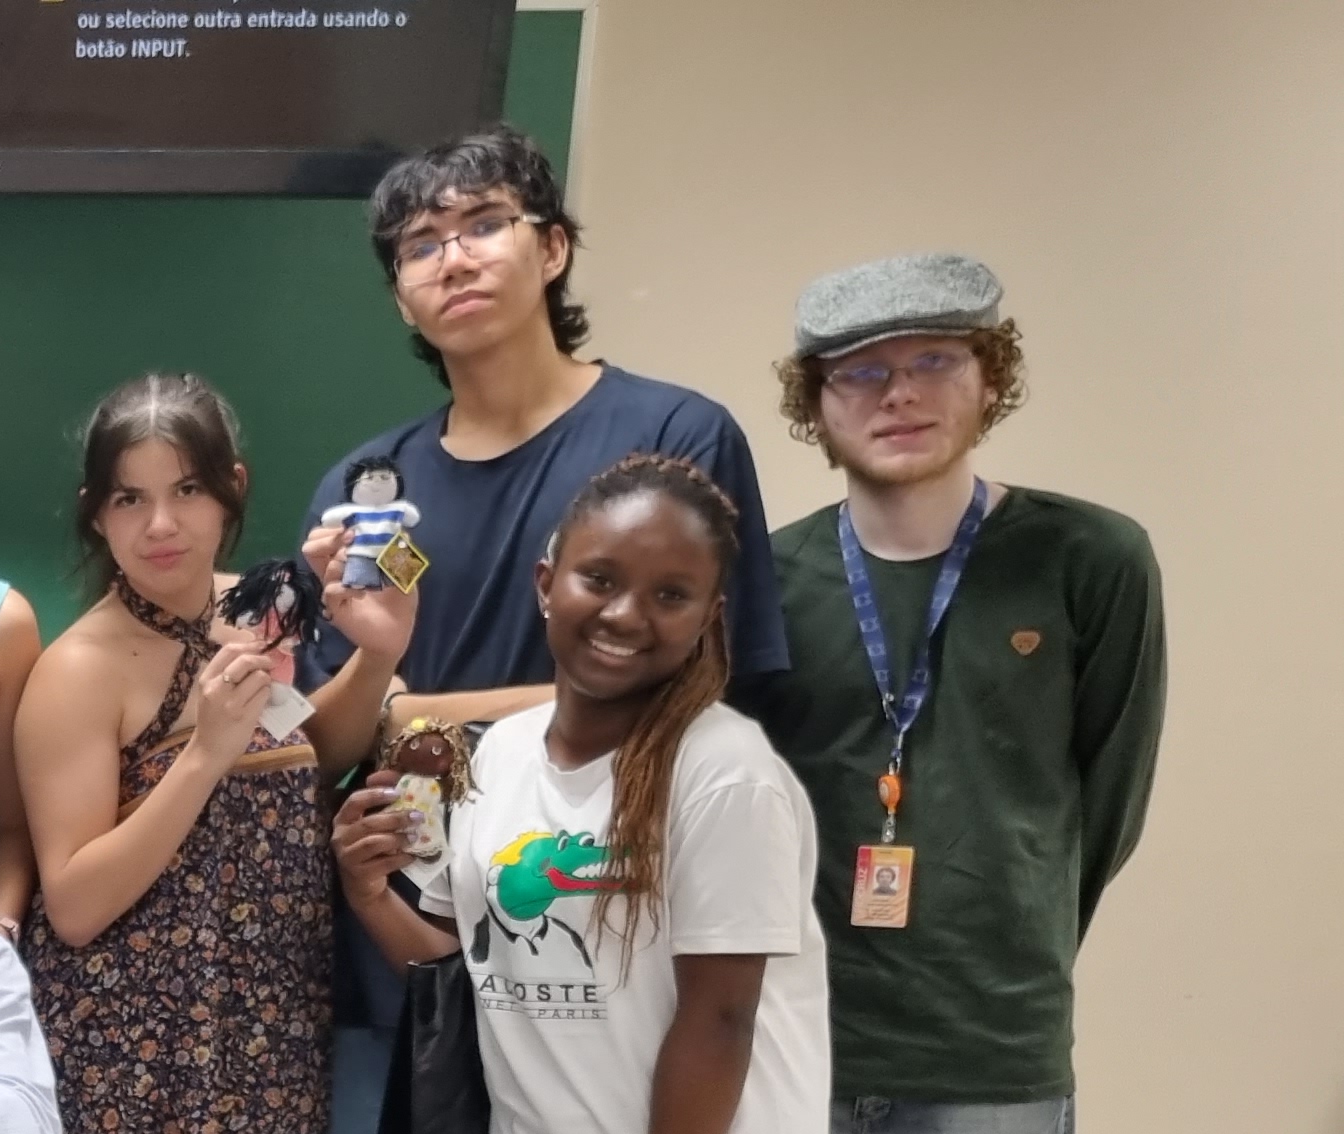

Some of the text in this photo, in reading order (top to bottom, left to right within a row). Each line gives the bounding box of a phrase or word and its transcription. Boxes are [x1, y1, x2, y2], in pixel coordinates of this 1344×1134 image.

[77, 8, 407, 29] ou selecione outra entrada usando o
[75, 37, 191, 59] botão INPUT.
[537, 1009, 600, 1020] PARIS
